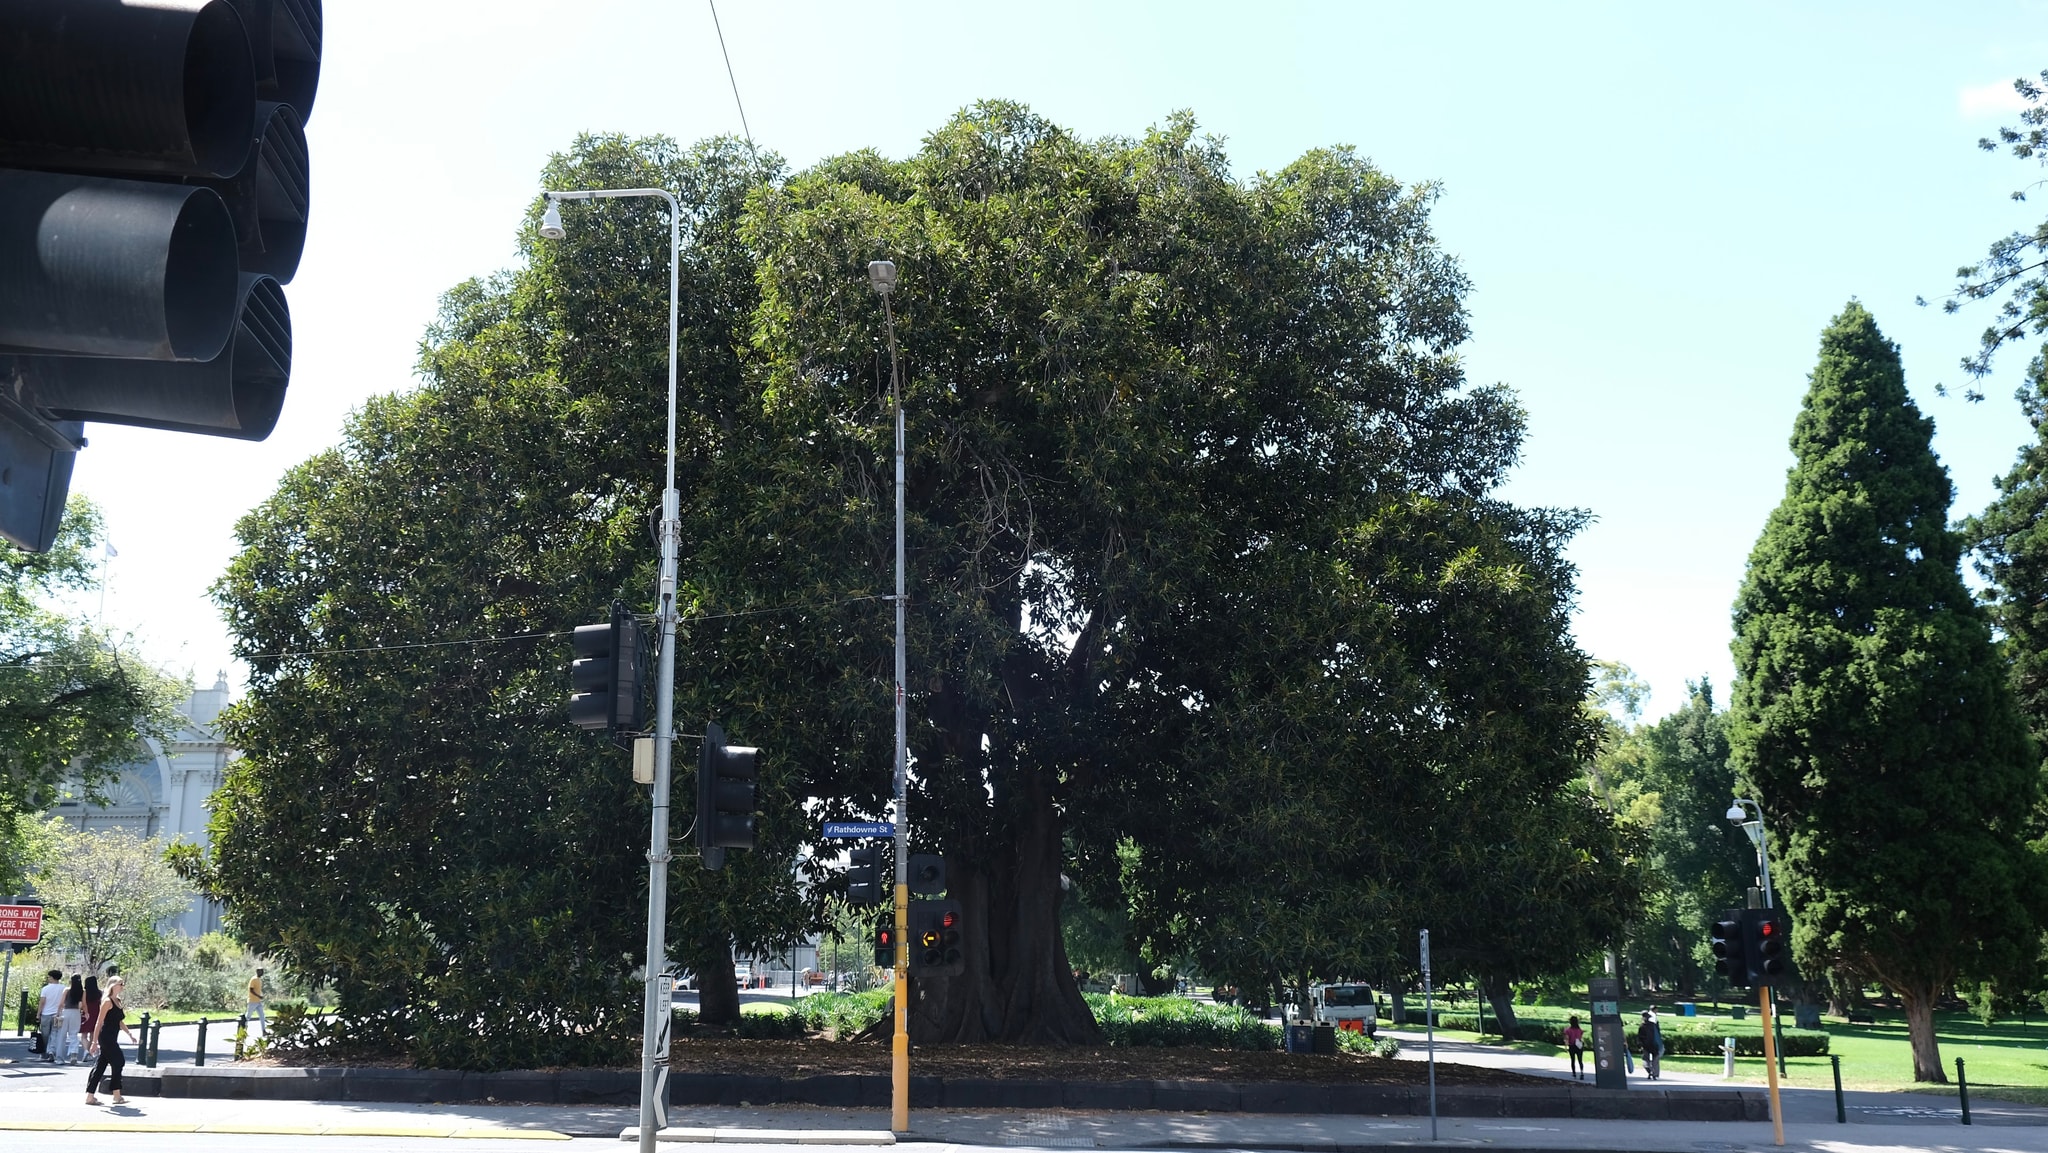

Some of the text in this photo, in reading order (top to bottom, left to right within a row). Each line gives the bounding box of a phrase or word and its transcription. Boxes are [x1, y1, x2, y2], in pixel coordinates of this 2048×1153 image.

[833, 825, 888, 833] Rathdowne St
[22, 910, 40, 918] WAY
[20, 921, 38, 929] TYRE
[0, 928, 27, 937] DAMAGE
